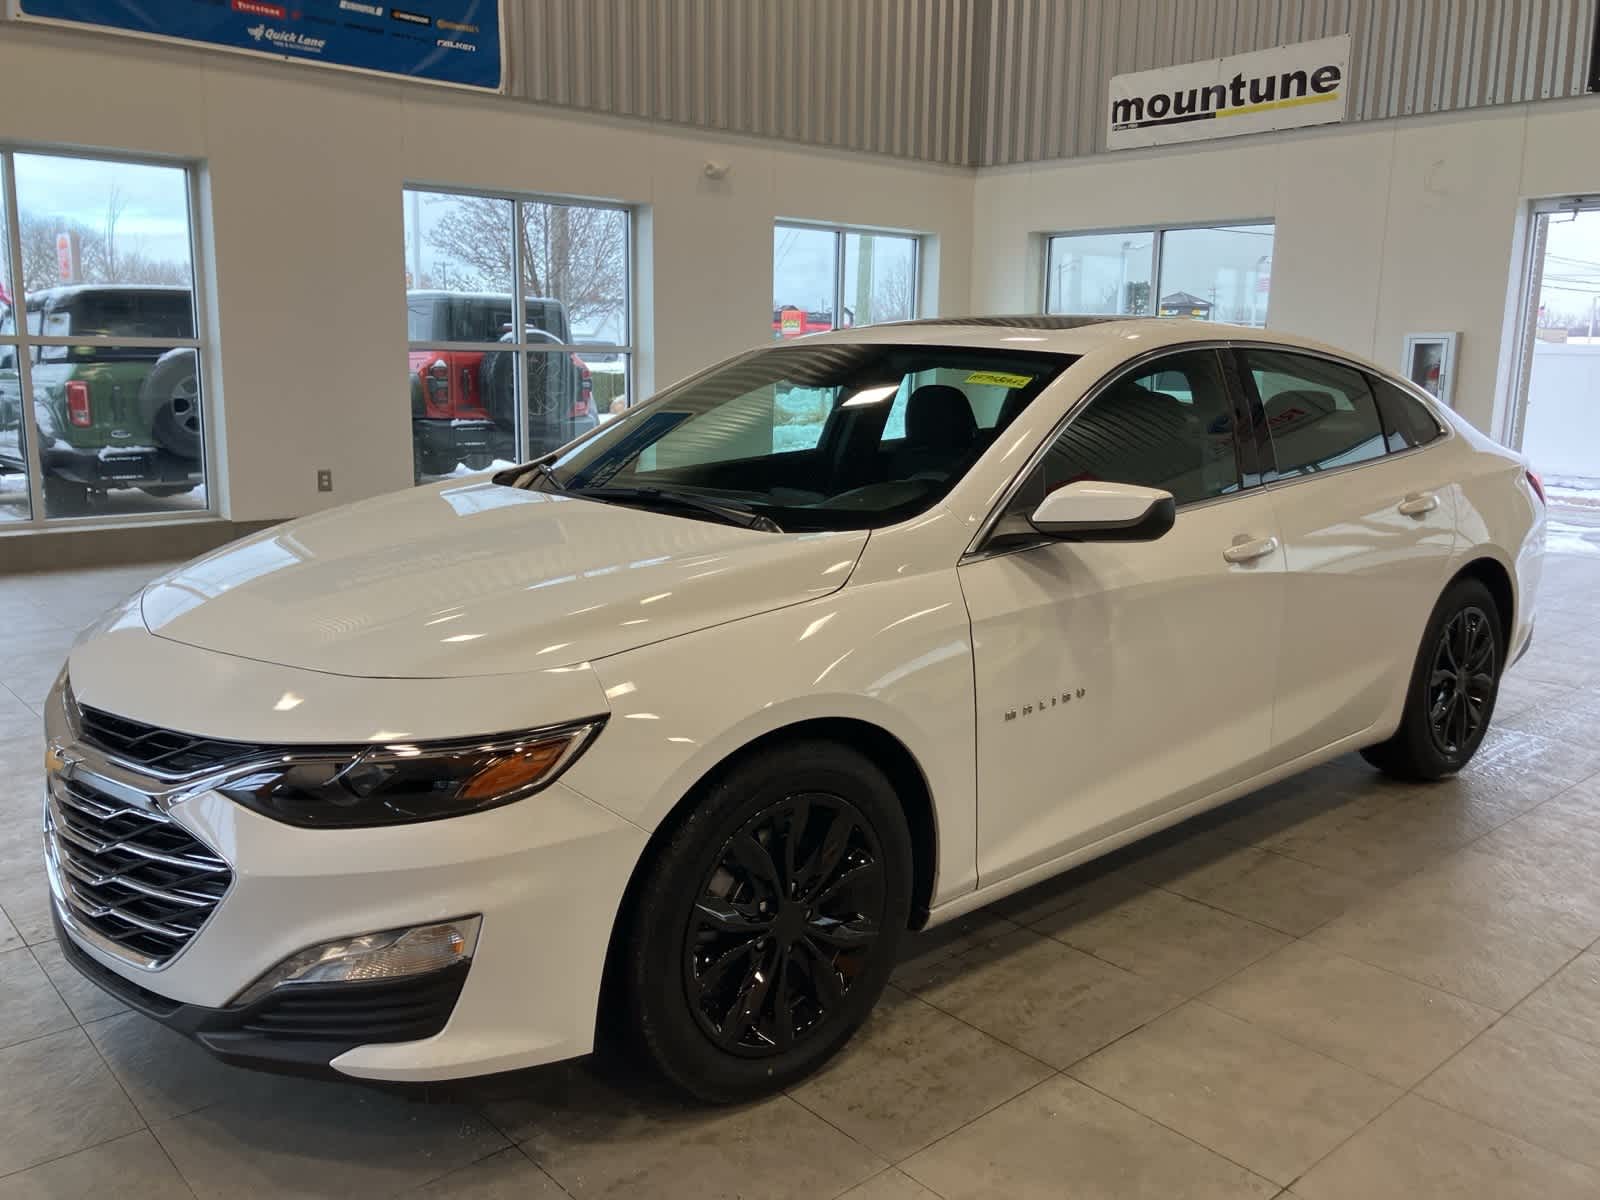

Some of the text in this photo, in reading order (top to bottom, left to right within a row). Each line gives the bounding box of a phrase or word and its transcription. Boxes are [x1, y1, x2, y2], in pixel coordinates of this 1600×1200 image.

[265, 28, 297, 42] Quick
[298, 34, 326, 47] Lane
[1112, 65, 1341, 123] mountune
[1004, 687, 1087, 721] MALIBU
